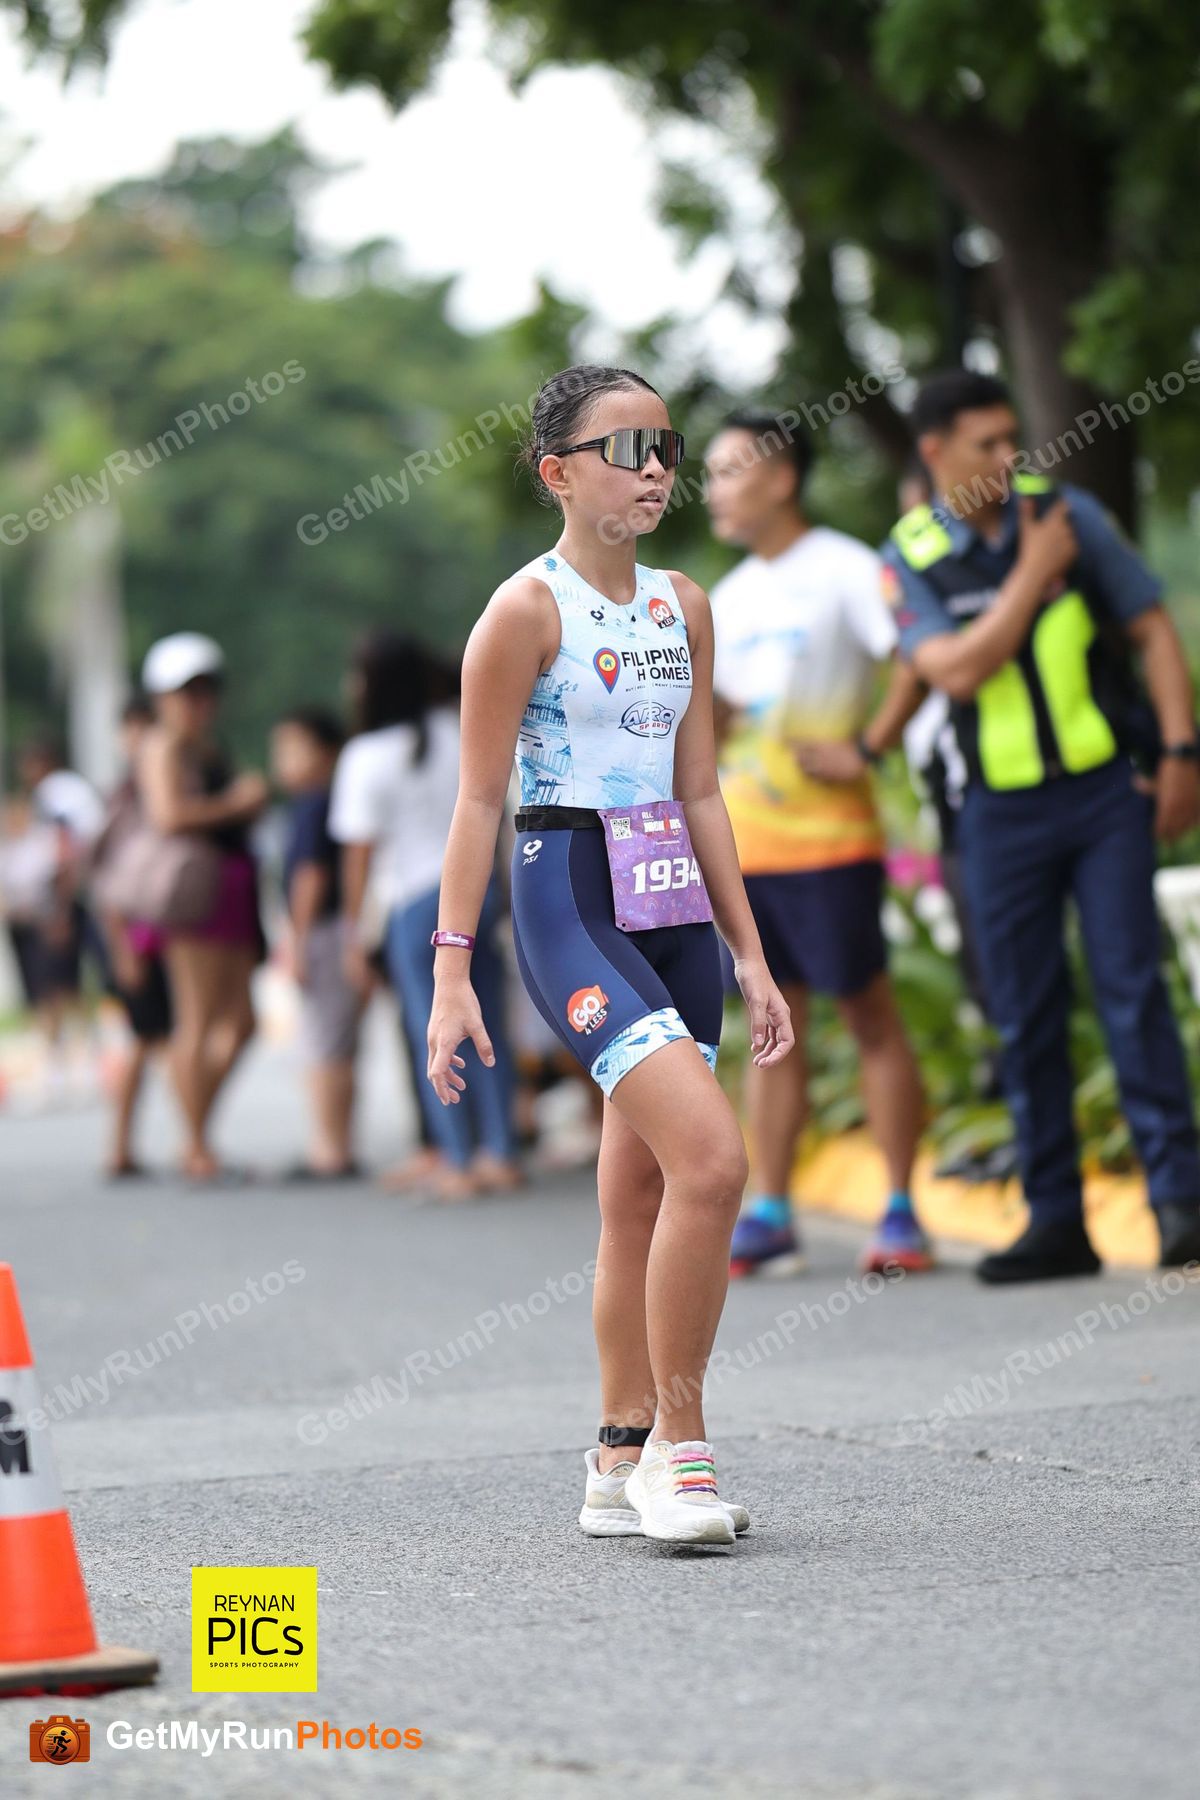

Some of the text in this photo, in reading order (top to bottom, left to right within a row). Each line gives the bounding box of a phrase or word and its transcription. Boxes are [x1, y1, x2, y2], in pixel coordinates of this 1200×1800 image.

[652, 604, 670, 621] GO
[621, 646, 689, 667] FILIPINO
[632, 857, 701, 894] 1934
[573, 995, 600, 1027] GO
[589, 1008, 607, 1028] LESS
